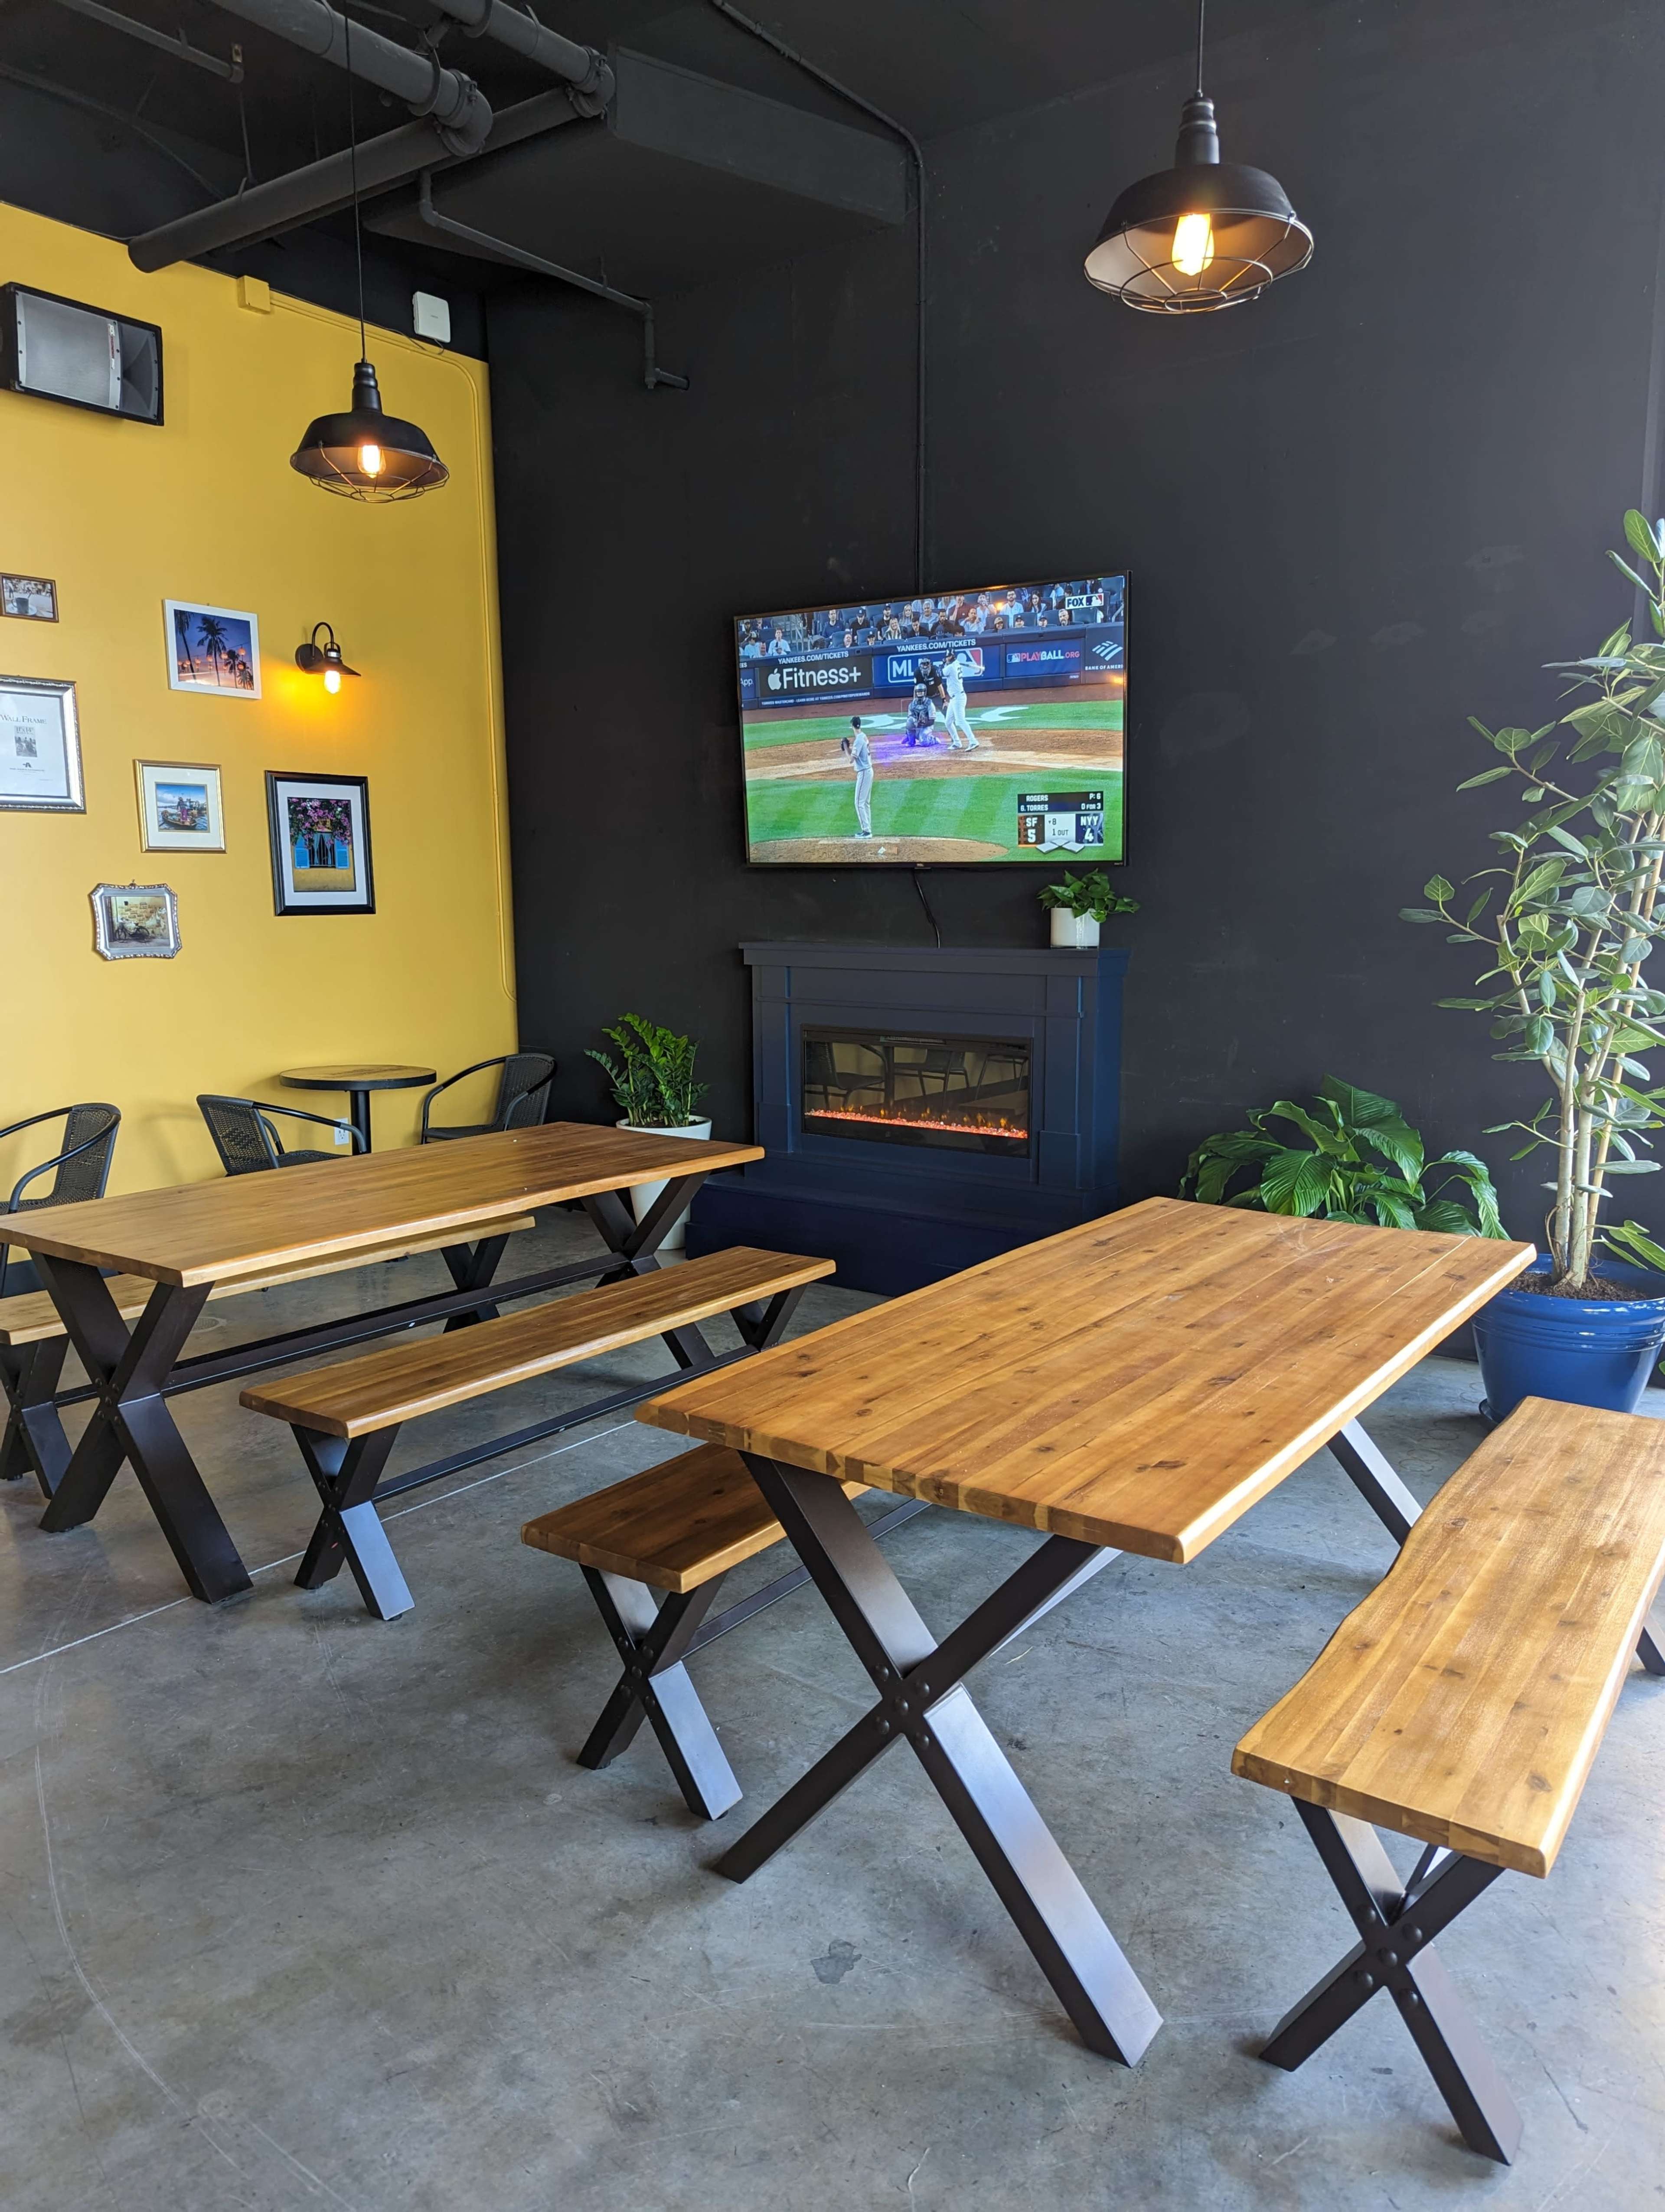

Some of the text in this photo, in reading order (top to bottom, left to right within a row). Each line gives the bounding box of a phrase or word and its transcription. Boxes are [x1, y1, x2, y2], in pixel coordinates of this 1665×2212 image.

[1067, 597, 1084, 608] FOX
[896, 638, 976, 652] YANKEES.COM/TICKETS
[777, 651, 849, 664] YANKEES.COM/TICKETS
[1020, 650, 1081, 662] PLAYBALL.ORG
[783, 666, 862, 689] Fitness+
[1026, 817, 1038, 827] SF
[1080, 816, 1099, 826] NYY
[1027, 829, 1036, 843] 5
[1084, 827, 1094, 842] 4
